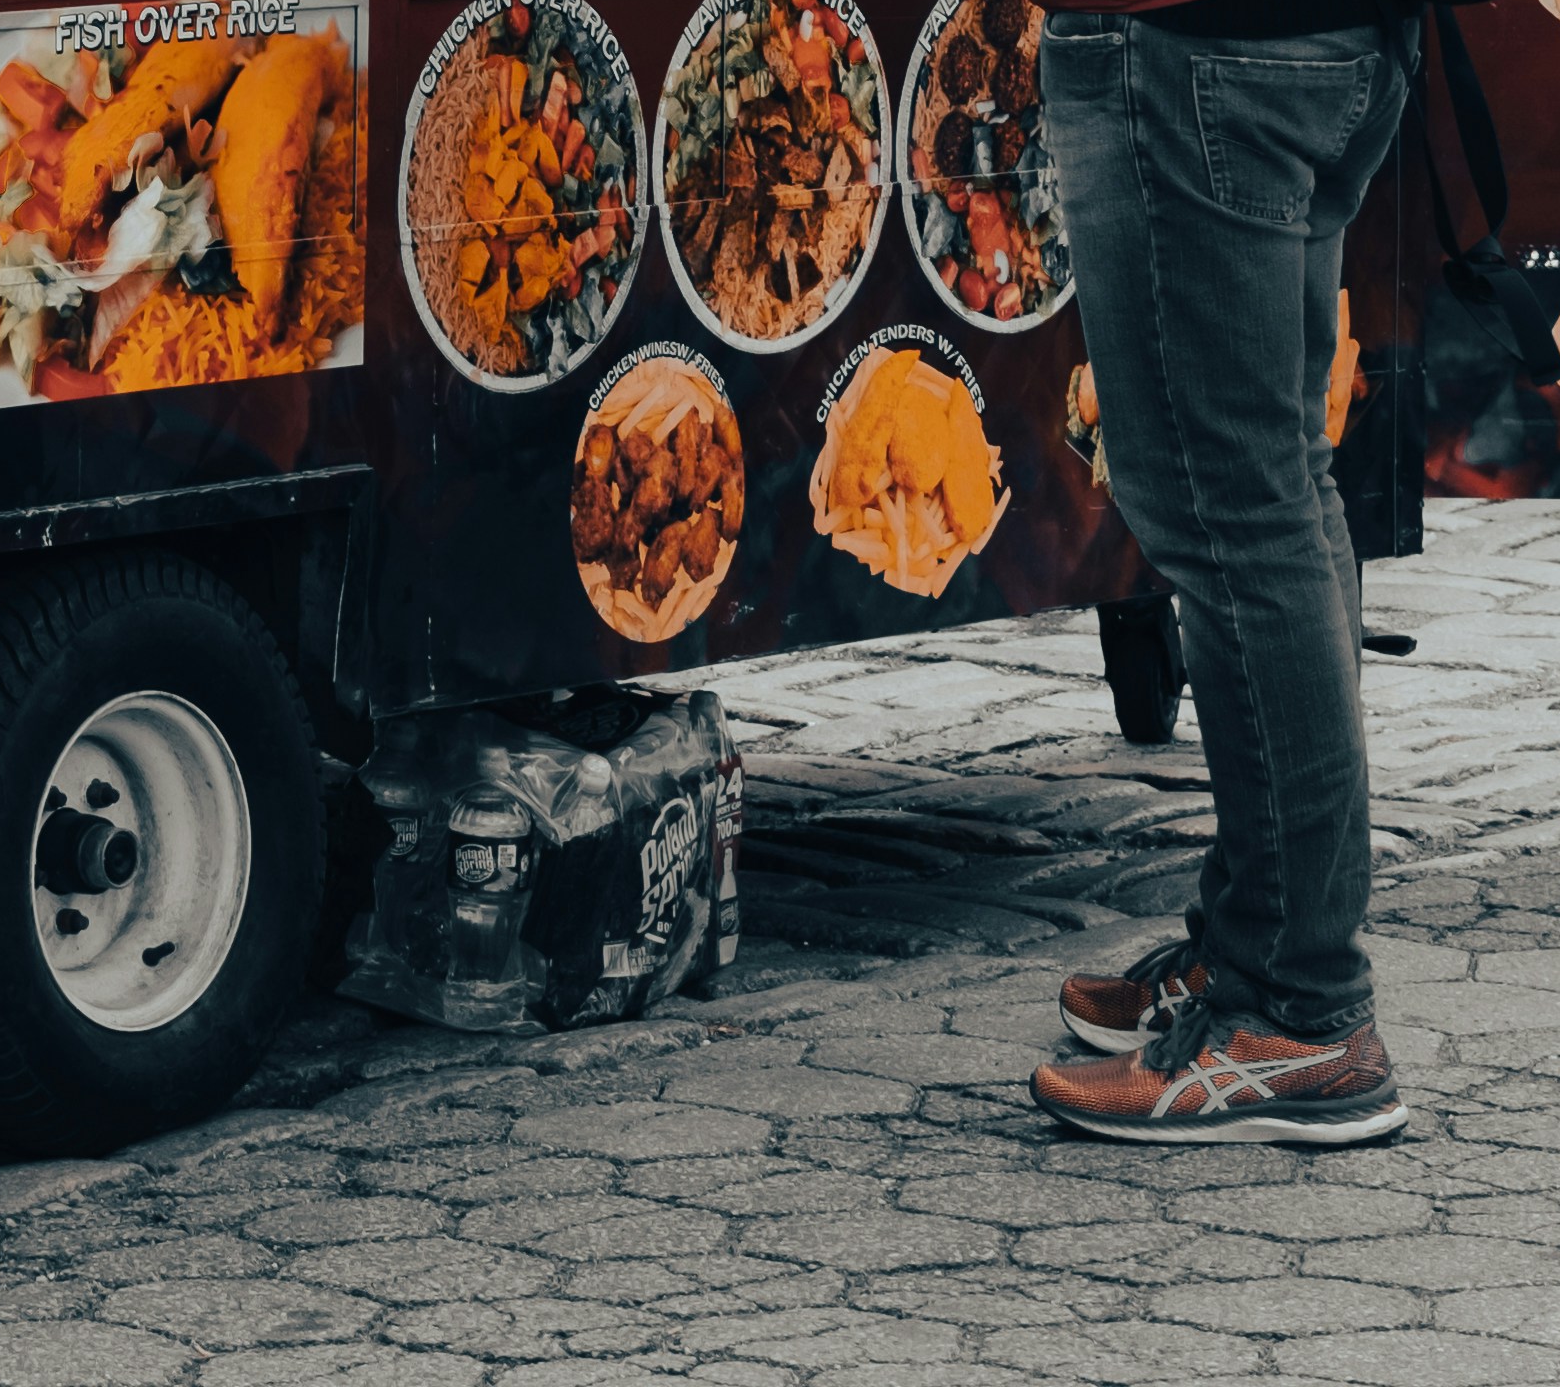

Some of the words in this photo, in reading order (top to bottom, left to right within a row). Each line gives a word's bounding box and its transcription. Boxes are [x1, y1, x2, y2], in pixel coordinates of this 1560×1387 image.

[56, 10, 128, 52] FISH
[134, 2, 221, 44] OVER
[589, 353, 638, 410] CHICKEN
[694, 355, 725, 393] FRIES
[716, 768, 742, 805] 24
[456, 846, 492, 863] Poland
[641, 793, 697, 895] Poland
[456, 859, 494, 874] Spring
